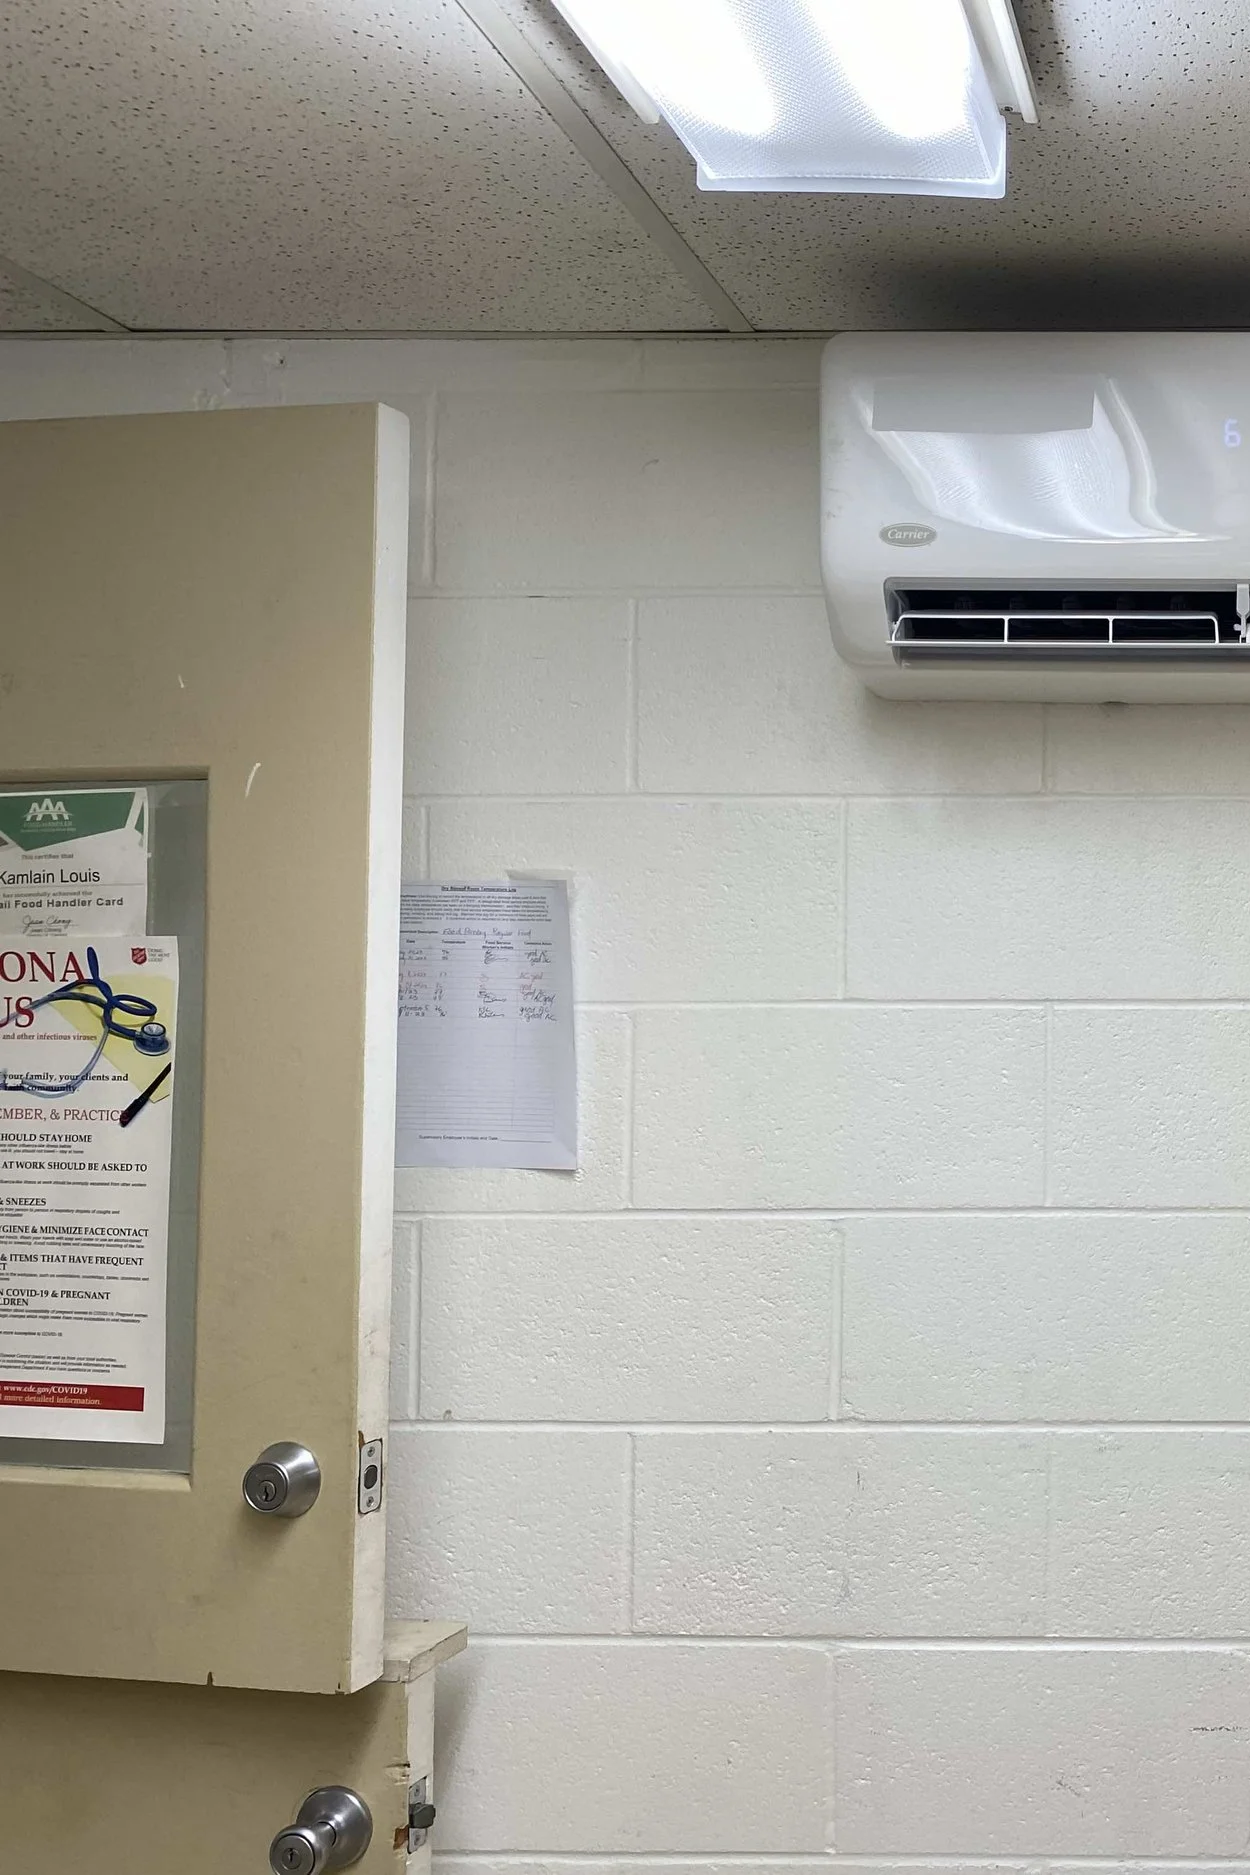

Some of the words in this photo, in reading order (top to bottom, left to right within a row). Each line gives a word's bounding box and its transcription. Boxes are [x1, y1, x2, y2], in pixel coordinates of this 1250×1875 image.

[1224, 418, 1241, 448] 6
[887, 528, 930, 540] Carrier
[26, 798, 70, 822] AAA
[0, 869, 55, 885] Kamlain
[60, 868, 100, 883] Louis
[15, 899, 43, 909] Food
[47, 898, 92, 908] Handler
[96, 897, 124, 907] Card
[2, 1032, 15, 1041] and
[17, 1032, 35, 1041] other
[36, 1032, 71, 1041] infectious
[72, 1033, 98, 1041] viruses
[25, 1072, 57, 1082] family,
[59, 1074, 79, 1083] your
[81, 1072, 110, 1082] clients
[111, 1073, 129, 1082] and
[0, 1108, 46, 1121] MBER,
[50, 1108, 60, 1121] &
[39, 1133, 63, 1142] STAY
[65, 1134, 93, 1143] HOME
[2, 1161, 14, 1169] AT
[16, 1161, 46, 1170] WORK
[47, 1161, 86, 1171] SHOULD
[88, 1162, 99, 1171] BE
[101, 1163, 133, 1172] ASKED
[134, 1163, 148, 1172] TO
[6, 1197, 47, 1206] SNEEZES
[31, 1226, 38, 1234] &
[40, 1225, 83, 1235] MINIMIZE
[85, 1227, 106, 1236] FACE
[106, 1227, 149, 1237] CONTACT
[9, 1253, 39, 1262] ITEMS
[41, 1254, 67, 1263] THAT
[68, 1255, 94, 1264] HAVE
[95, 1256, 144, 1267] FREQUENT
[6, 1288, 49, 1298] COVID-19
[51, 1290, 58, 1298] &
[60, 1290, 111, 1300] PREGNANT
[3, 1384, 88, 1395] www.cdc.gov/COVID19
[24, 1394, 55, 1403] detailed
